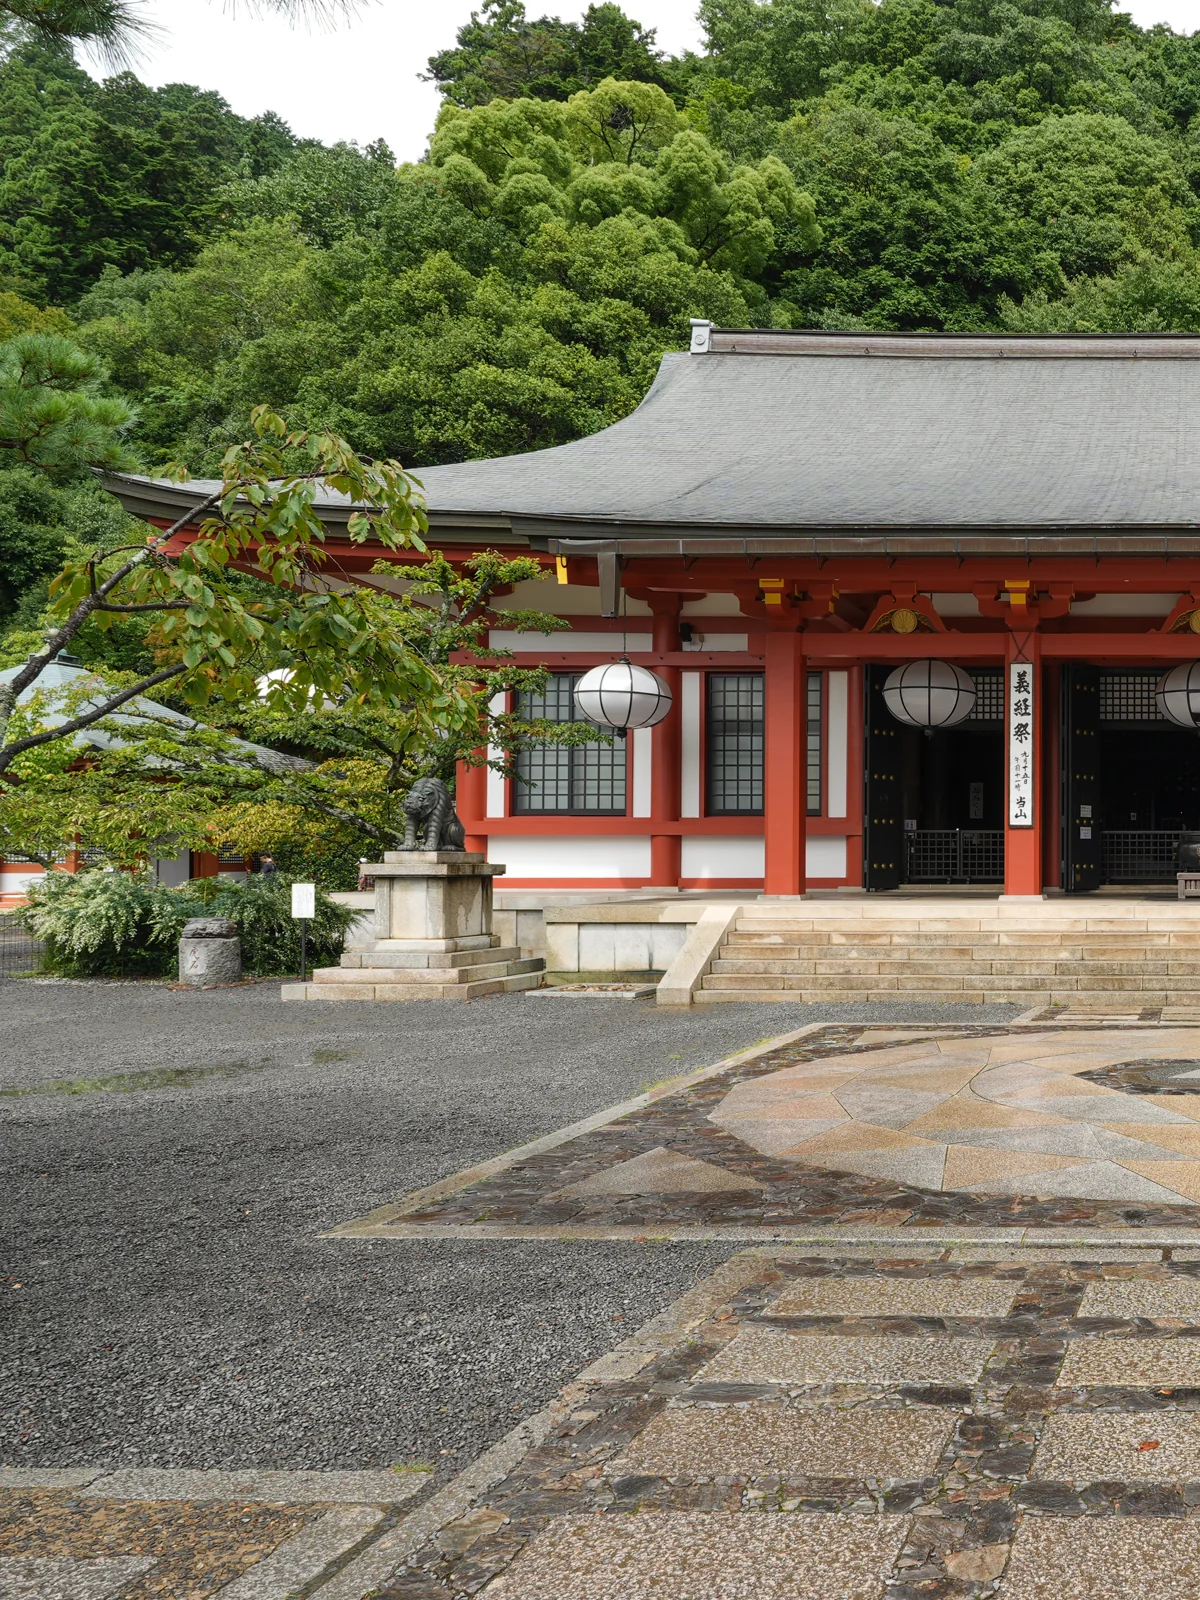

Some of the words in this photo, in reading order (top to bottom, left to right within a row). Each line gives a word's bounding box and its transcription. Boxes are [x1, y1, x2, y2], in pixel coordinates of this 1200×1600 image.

[1013, 670, 1031, 744] 義経祭
[1021, 751, 1030, 784] 九月十五日
[972, 787, 981, 817] おみくじ
[1014, 796, 1027, 819] 当山
